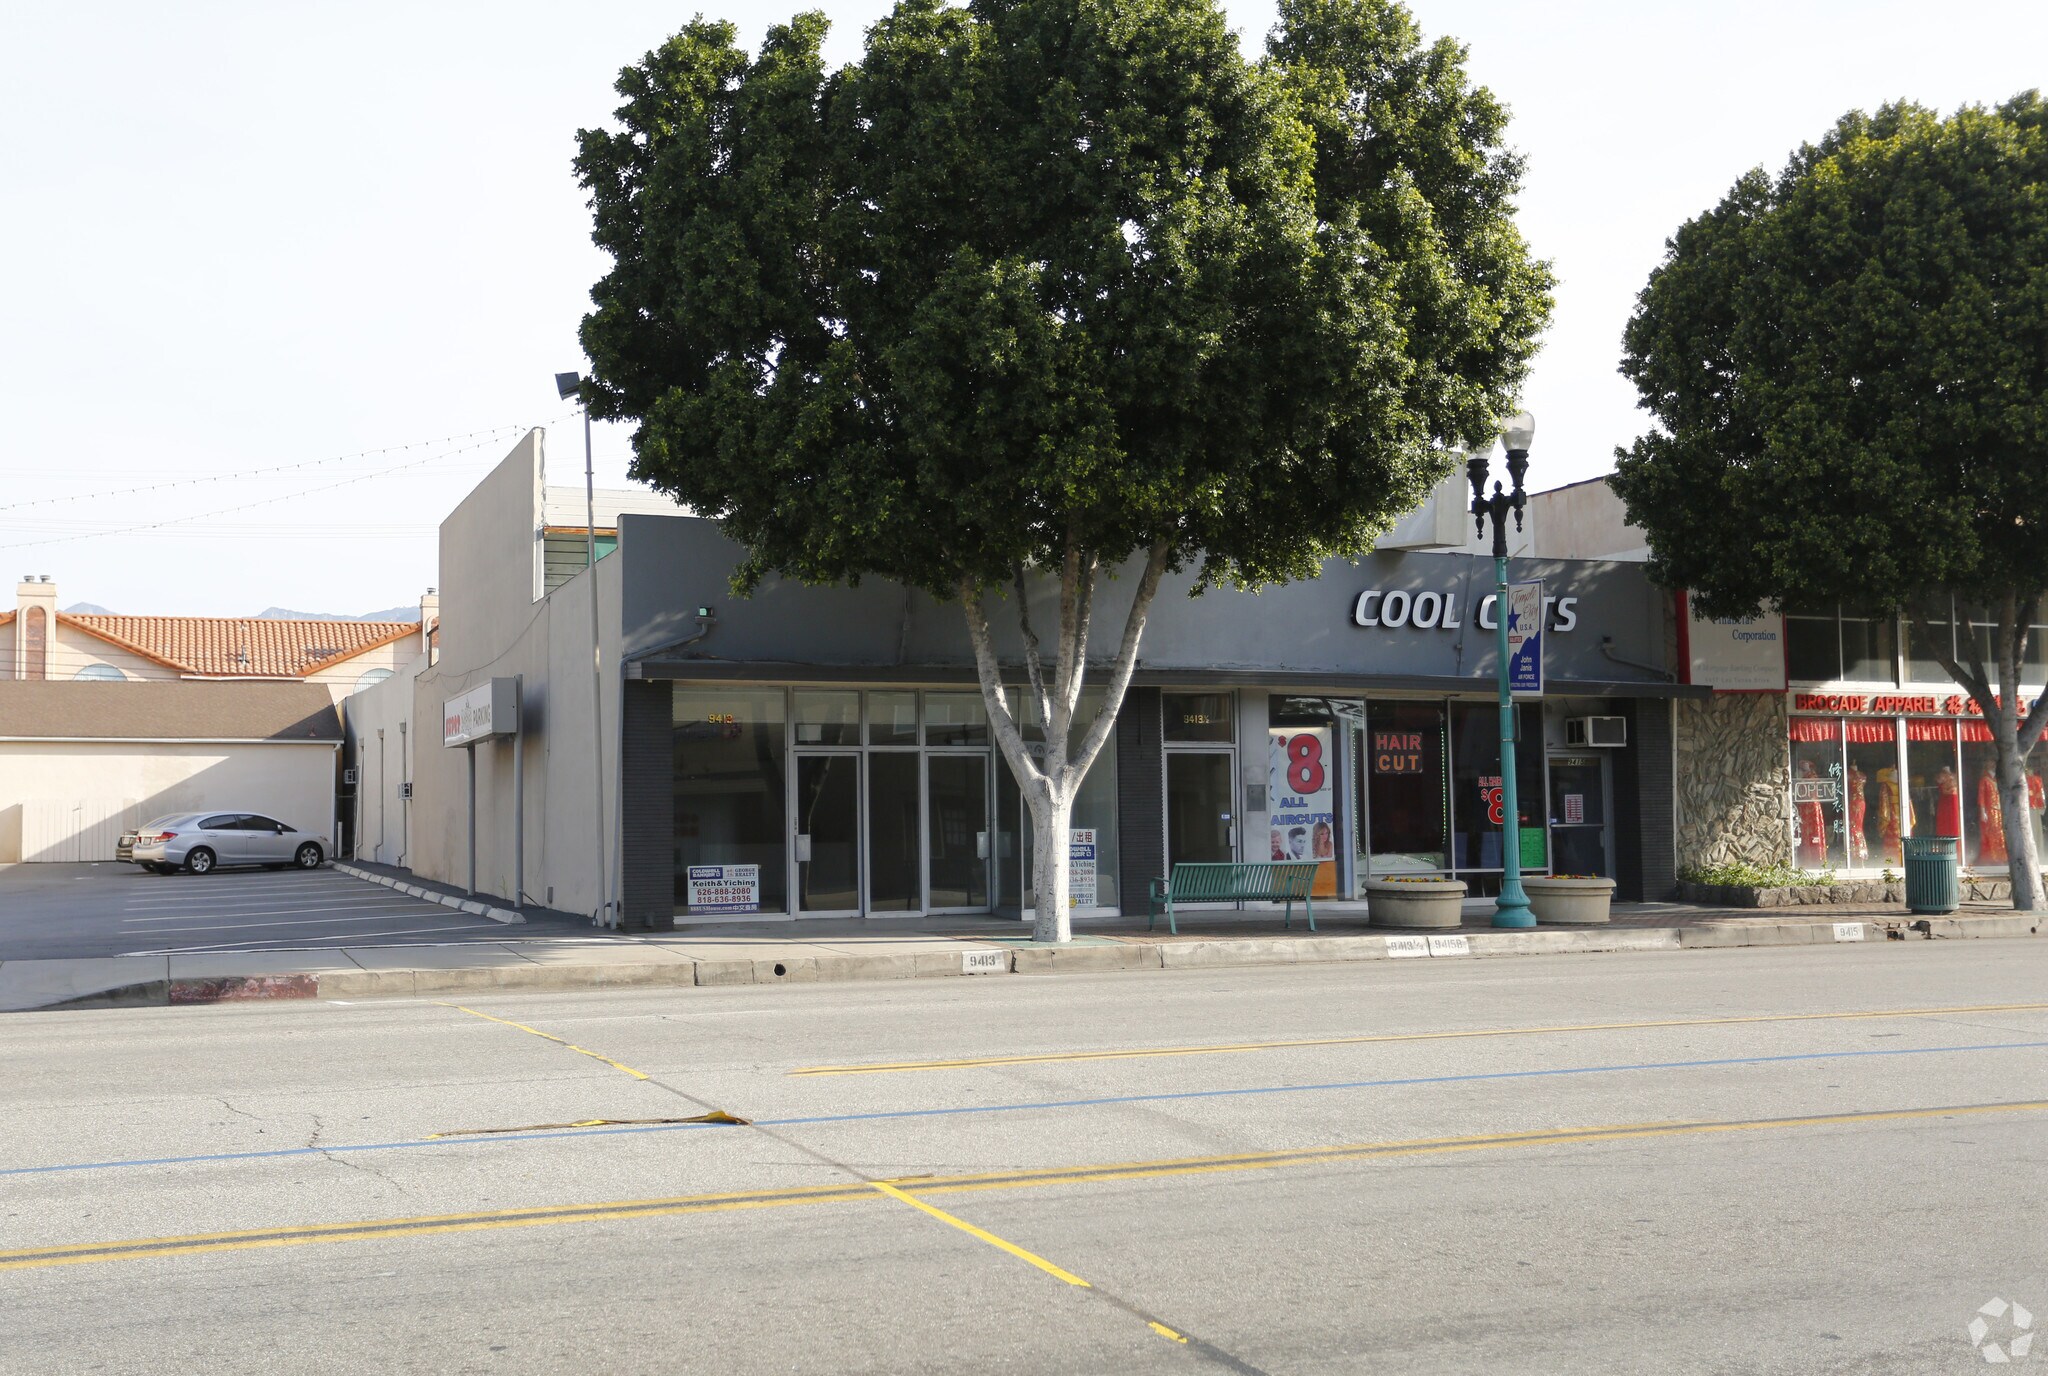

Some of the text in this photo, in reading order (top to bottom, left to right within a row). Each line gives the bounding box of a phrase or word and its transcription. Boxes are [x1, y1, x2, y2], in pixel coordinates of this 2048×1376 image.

[1355, 590, 1578, 632] COOL CTS
[1732, 629, 1776, 643] Corporation
[1796, 694, 1868, 711] BROCADE
[1875, 696, 1939, 713] APPAREL
[473, 704, 491, 728] PARKING
[1376, 735, 1421, 750] HAIR
[1379, 755, 1418, 770] CUT
[1797, 784, 1835, 798] OPEN
[1280, 797, 1308, 808] ALL
[1271, 813, 1333, 825] AIRCUTS
[1840, 927, 1859, 936] 9415
[970, 955, 996, 966] 9413
